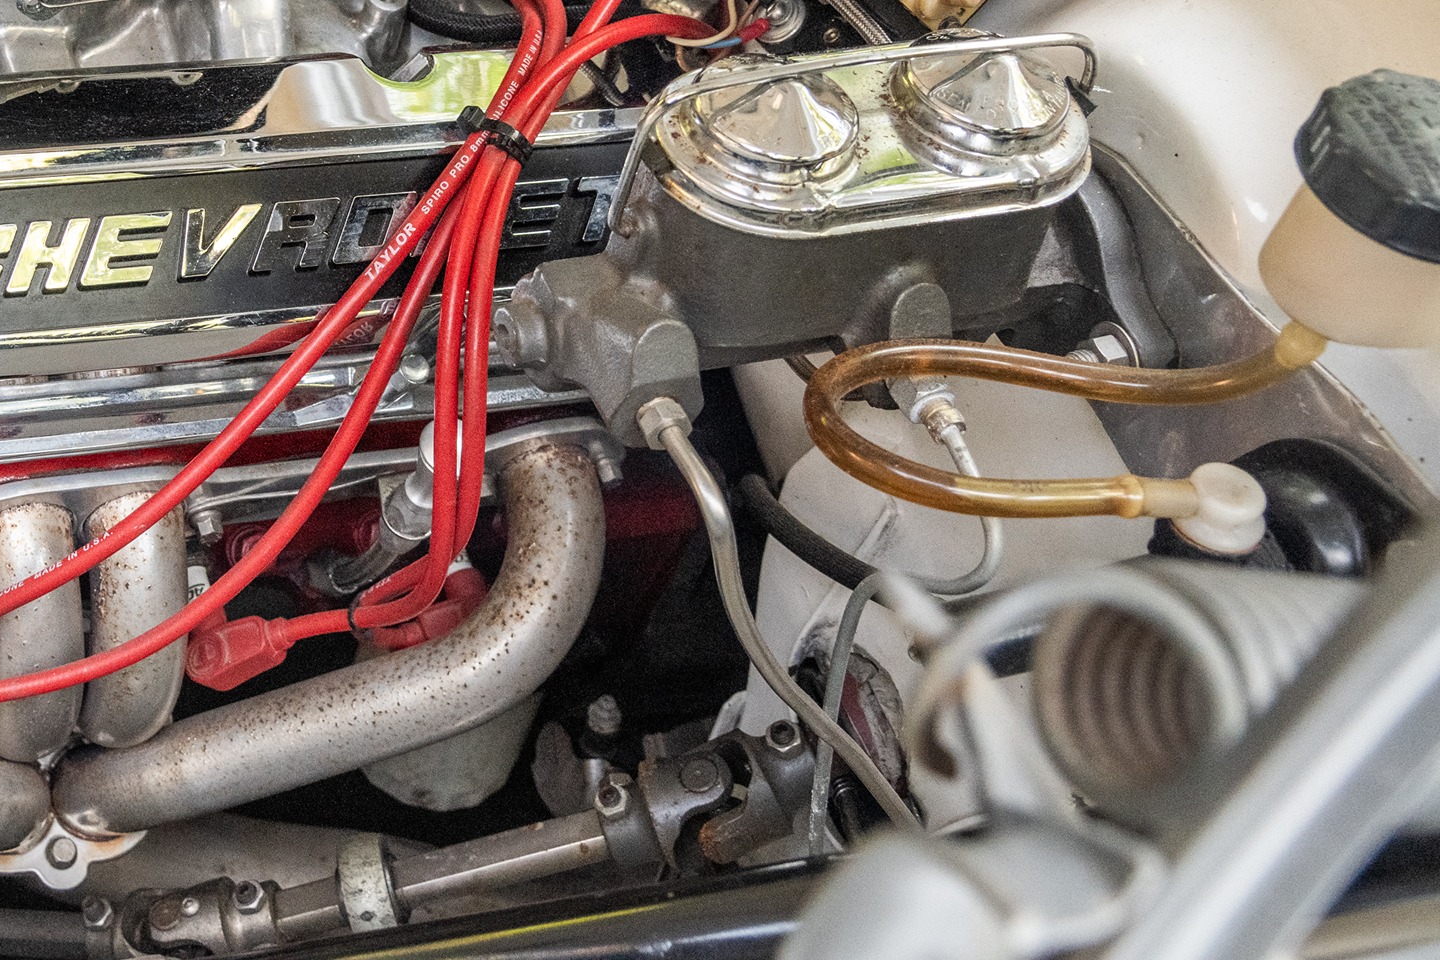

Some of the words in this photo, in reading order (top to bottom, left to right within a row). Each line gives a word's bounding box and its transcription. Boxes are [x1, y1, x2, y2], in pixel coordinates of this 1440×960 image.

[365, 222, 417, 281] TAYLOR
[421, 181, 449, 215] SPIRO
[449, 155, 470, 179] PRO
[491, 80, 519, 120] ILICONE
[517, 54, 533, 77] MADE
[529, 44, 538, 55] IN
[33, 561, 63, 580] MADE
[67, 550, 79, 562] IN
